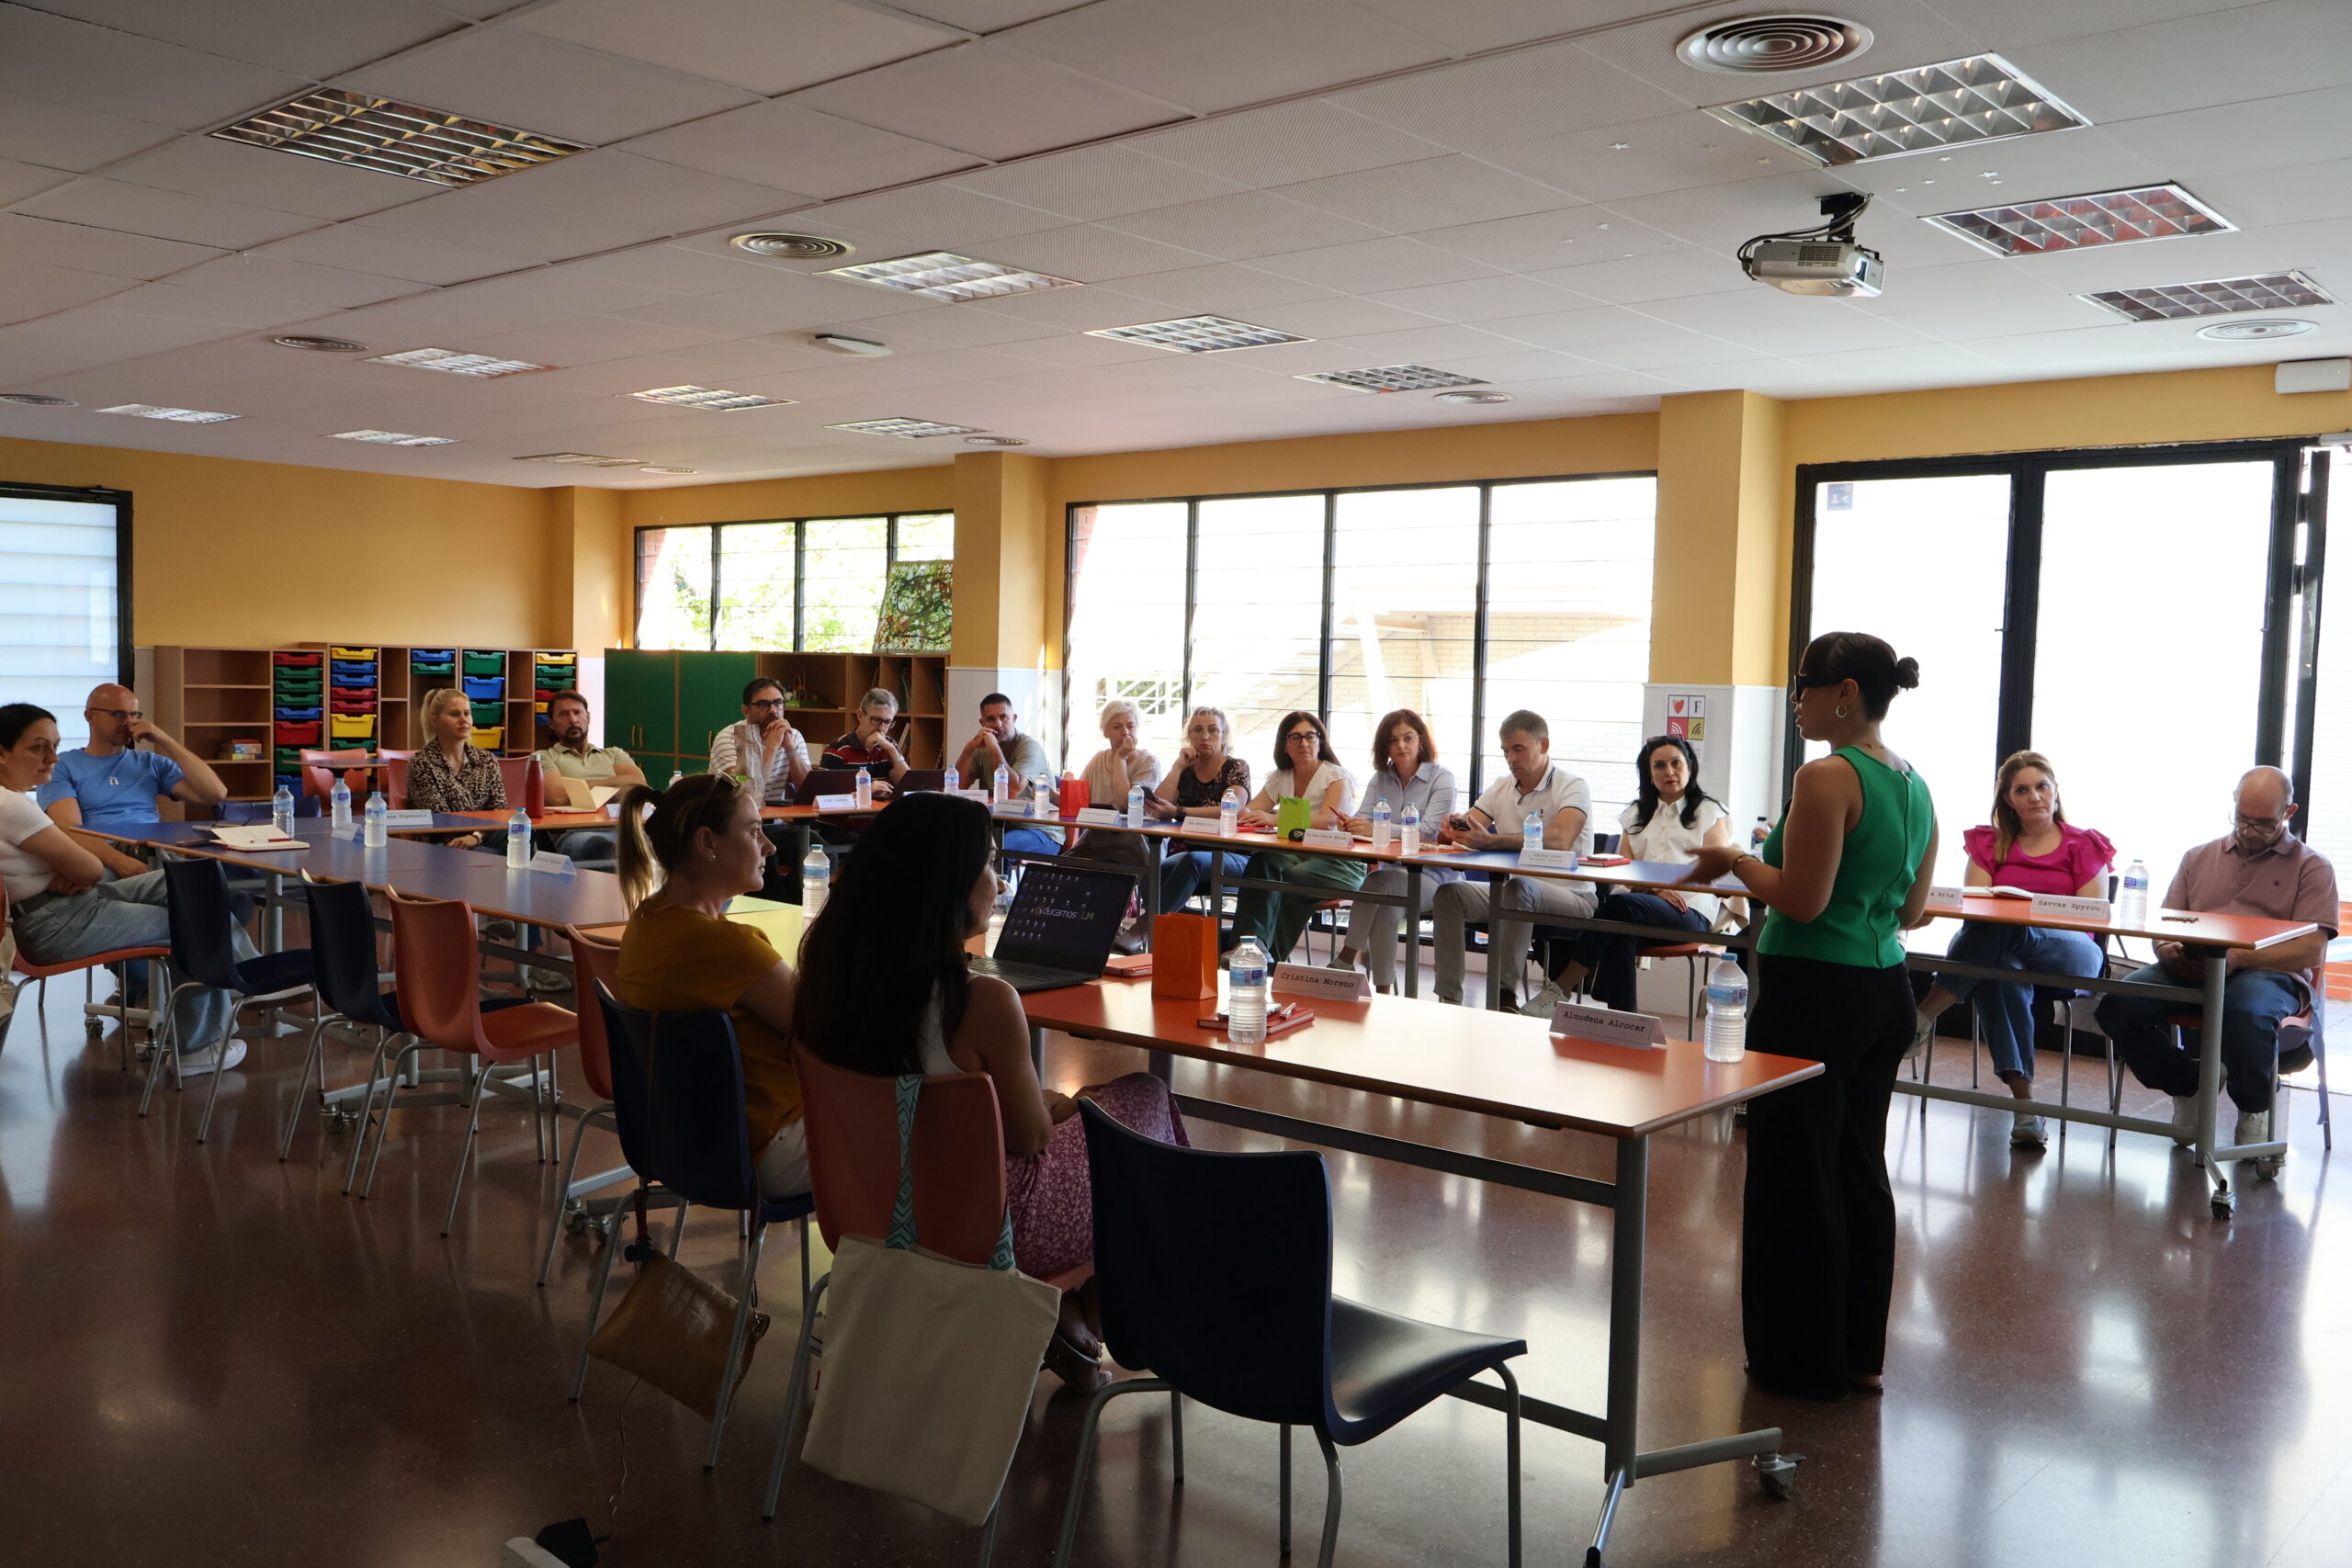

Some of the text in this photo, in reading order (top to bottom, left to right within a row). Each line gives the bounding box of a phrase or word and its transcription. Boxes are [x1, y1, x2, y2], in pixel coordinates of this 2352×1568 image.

[1694, 700, 1702, 714] F
[2071, 903, 2100, 911] Spyrou
[1281, 972, 1354, 988] Cristina Moreno
[1564, 1011, 1646, 1032] Almudena Alcocer
